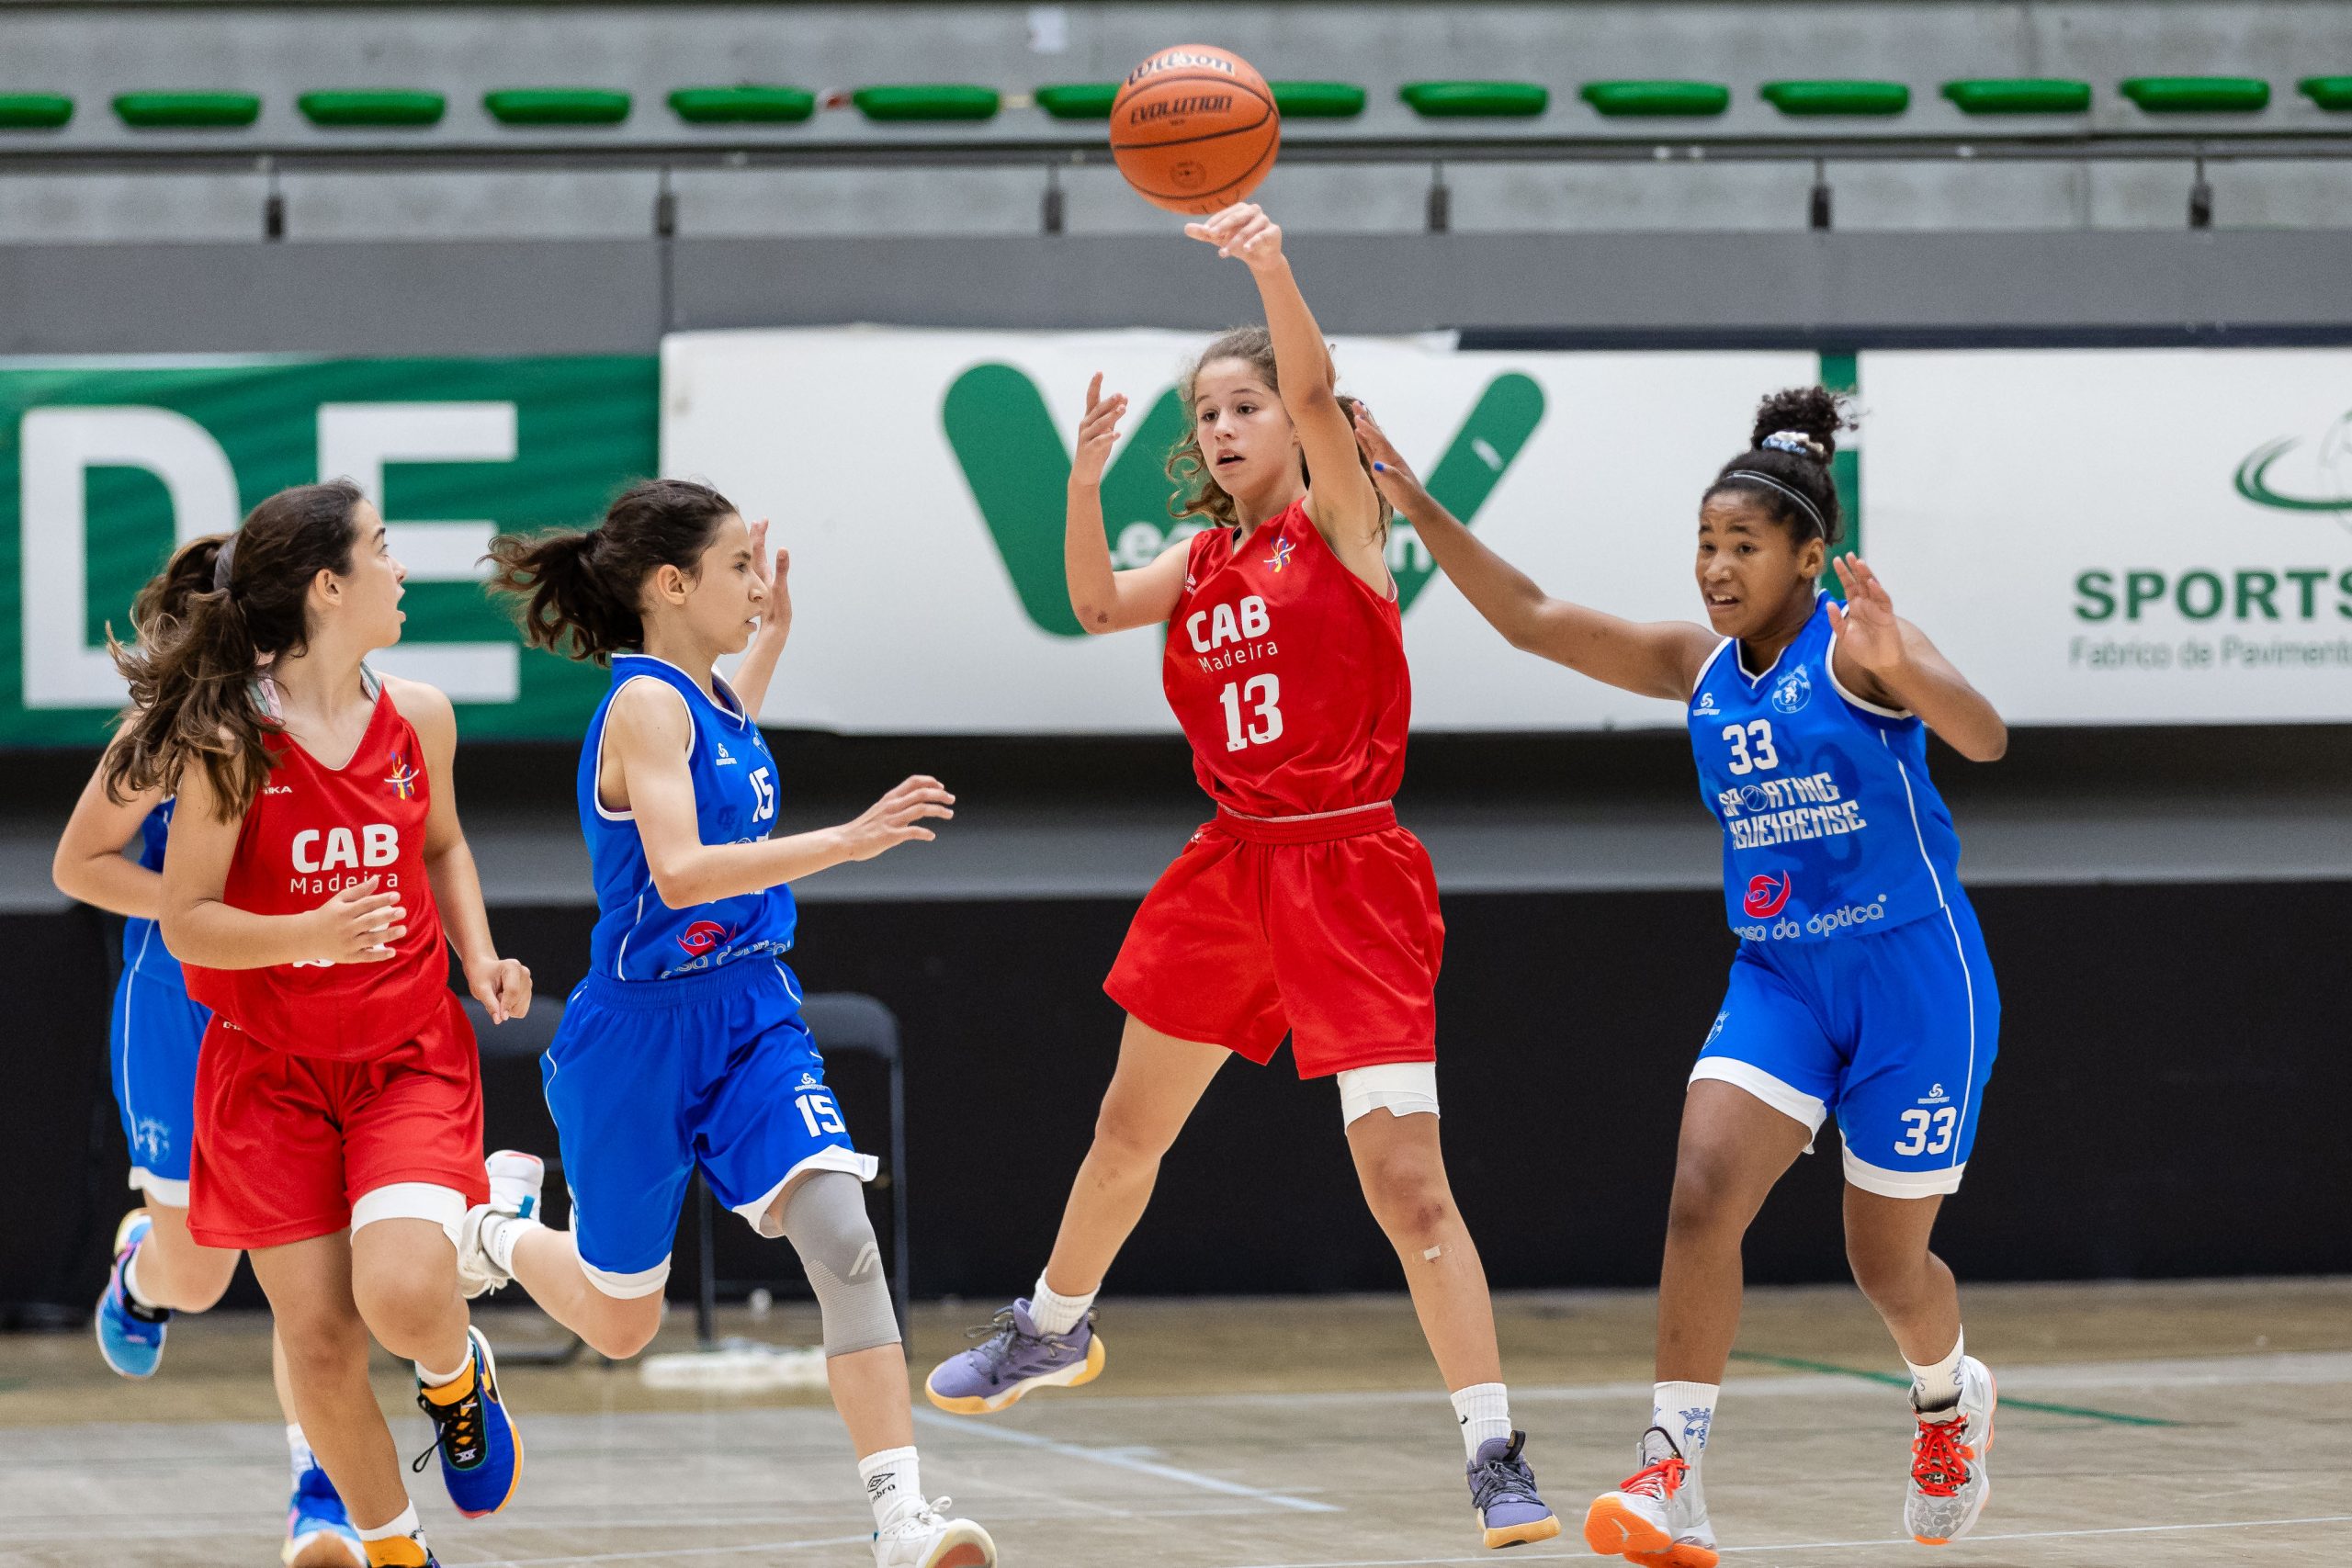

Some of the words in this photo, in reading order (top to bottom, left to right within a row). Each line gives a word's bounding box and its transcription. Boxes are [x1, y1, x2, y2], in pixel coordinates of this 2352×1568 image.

[1128, 51, 1235, 86] Wilson
[1130, 96, 1233, 126] EVOLUTION
[20, 400, 518, 708] DE
[1185, 595, 1271, 654] CAB
[1198, 640, 1278, 674] Madeira
[2177, 636, 2216, 670] de
[1219, 673, 1283, 752] 13
[1722, 719, 1779, 775] 33
[749, 766, 774, 823] 15
[291, 823, 400, 874] CAB
[290, 871, 398, 895] Madeia
[1772, 917, 1800, 941] da
[1806, 903, 1884, 937] óptica
[794, 1094, 846, 1138] 15
[1894, 1106, 1957, 1156] 33
